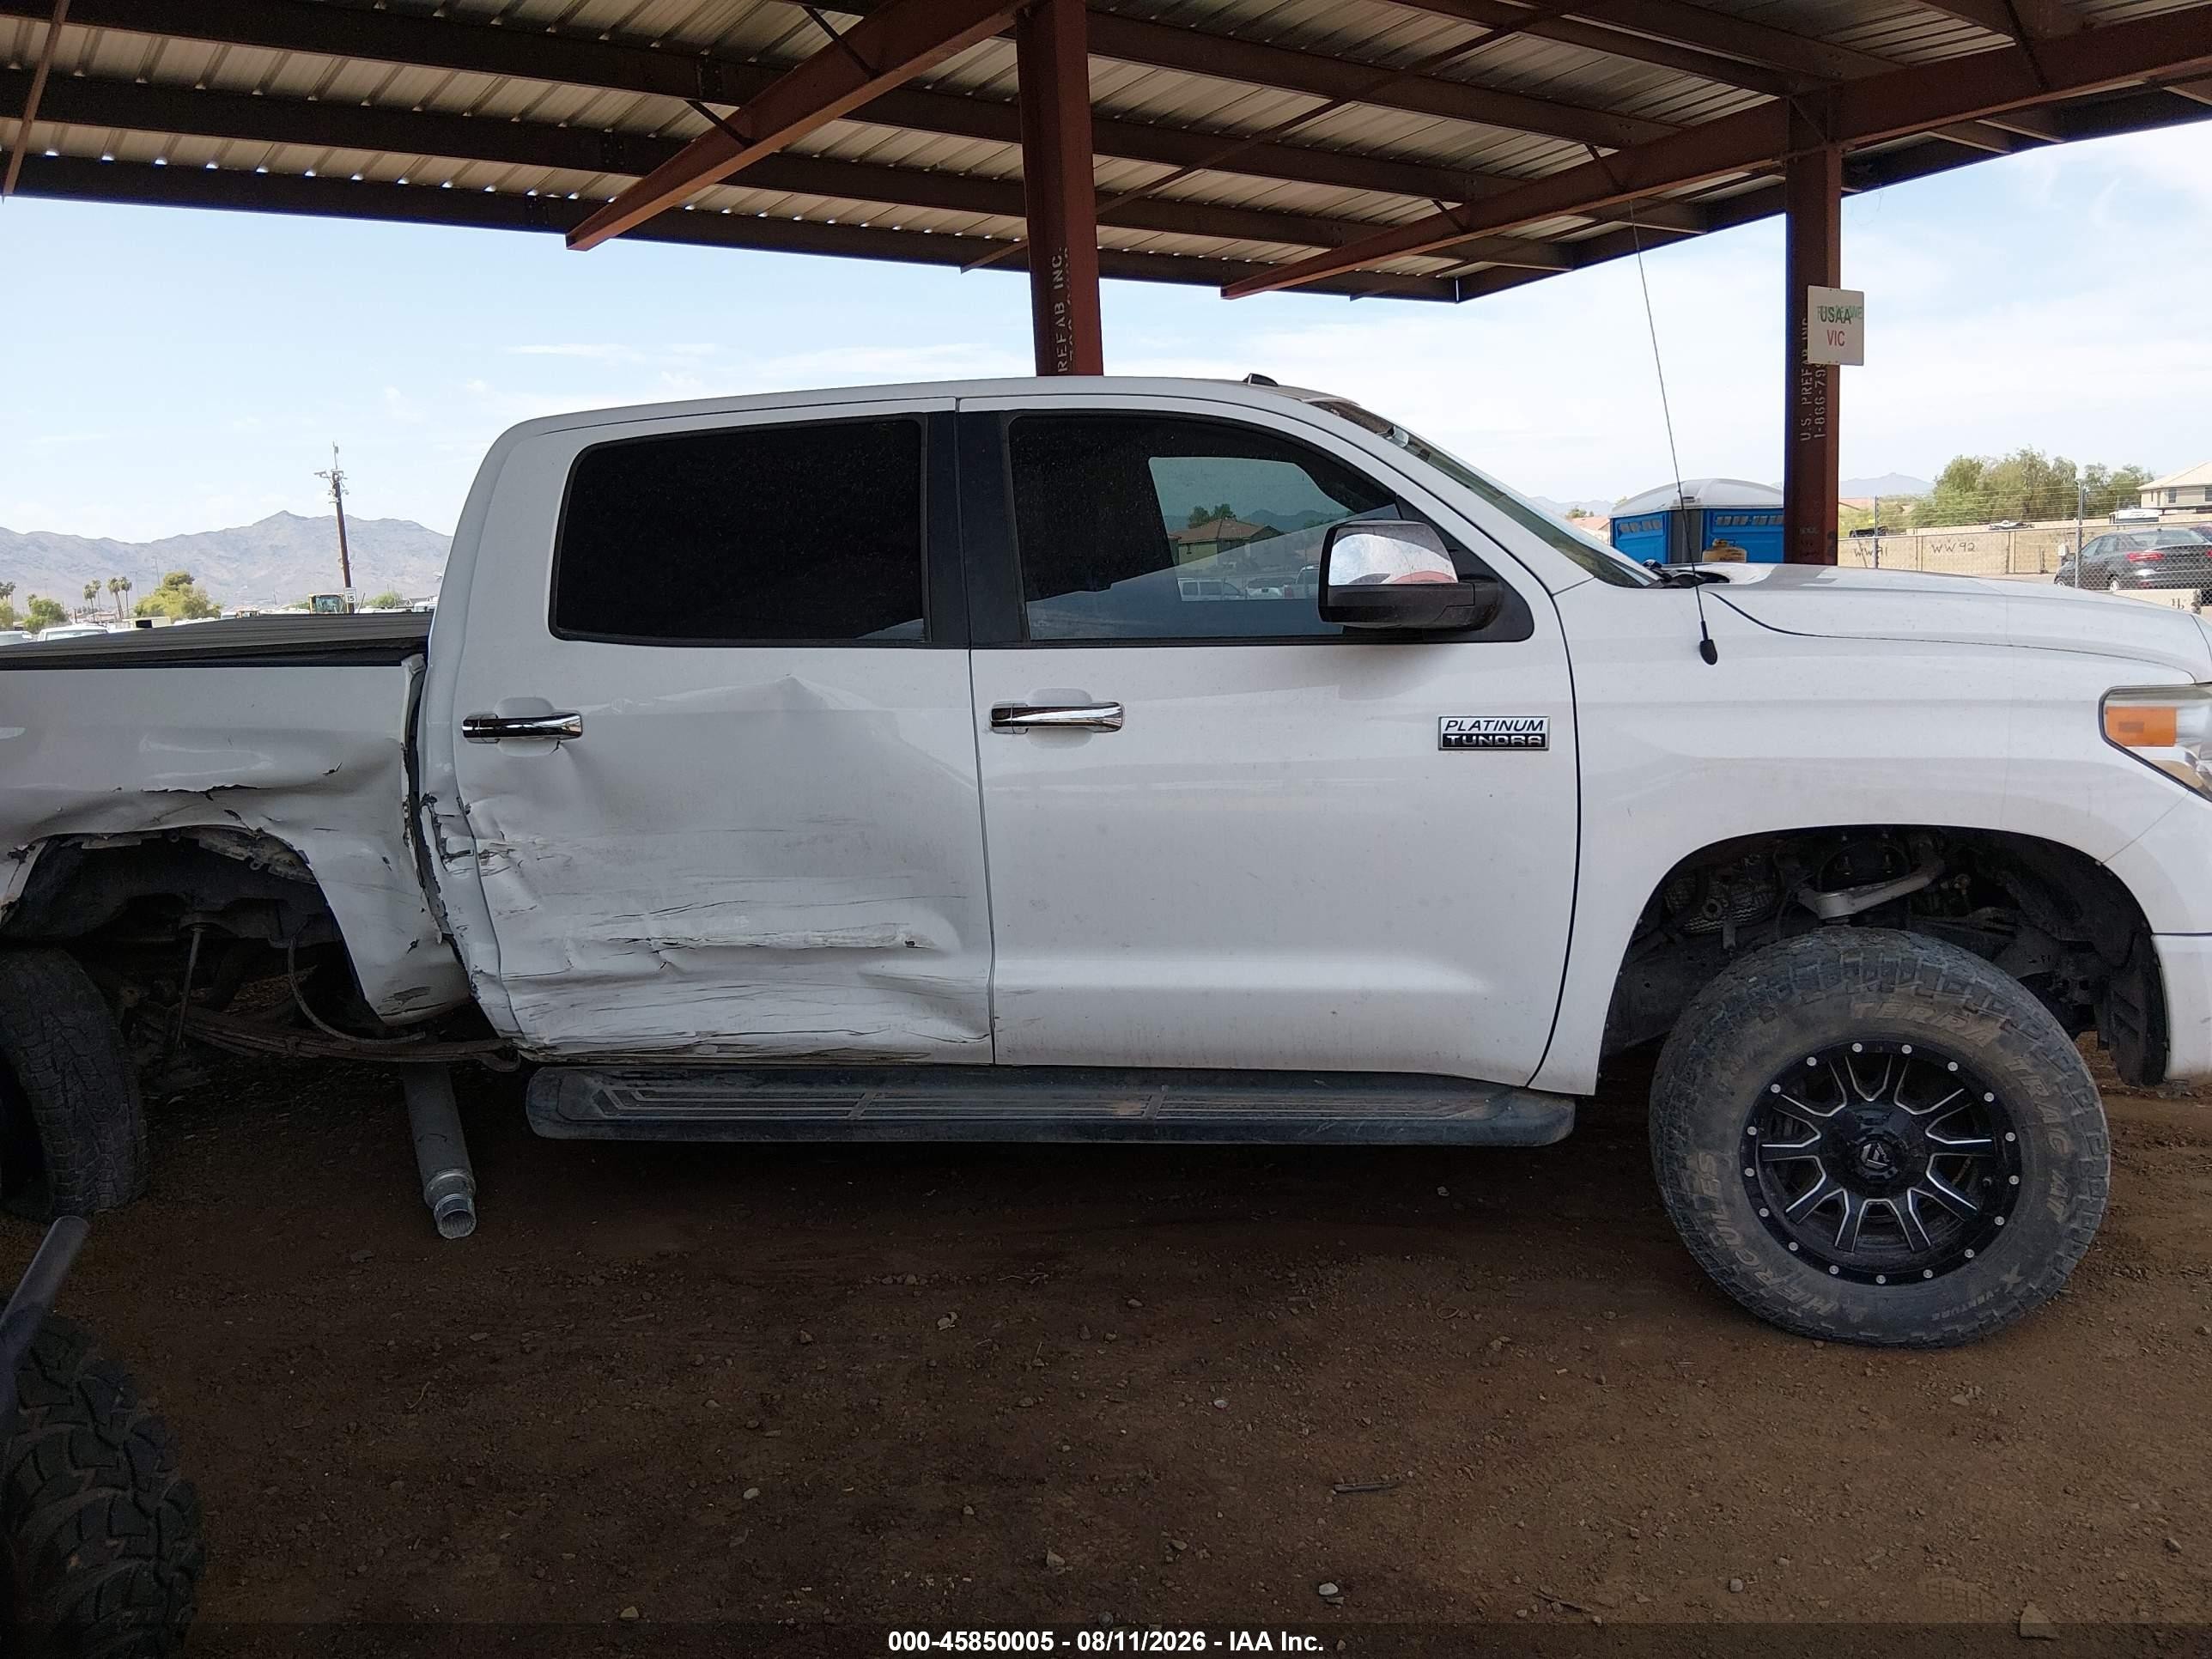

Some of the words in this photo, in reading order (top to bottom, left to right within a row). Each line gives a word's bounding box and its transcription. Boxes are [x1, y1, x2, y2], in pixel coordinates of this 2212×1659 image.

[1051, 246, 1065, 289] INC.
[1820, 305, 1852, 325] USAA
[1826, 329, 1845, 346] VIC
[1799, 413, 1812, 441] U.S.
[1444, 720, 1545, 732] PLATINUM
[1446, 734, 1543, 746] TUNDRA
[1852, 1001, 1996, 1048] TERRA
[2009, 1056, 2070, 1154] TRAC
[1692, 1153, 1841, 1316] HERCULES
